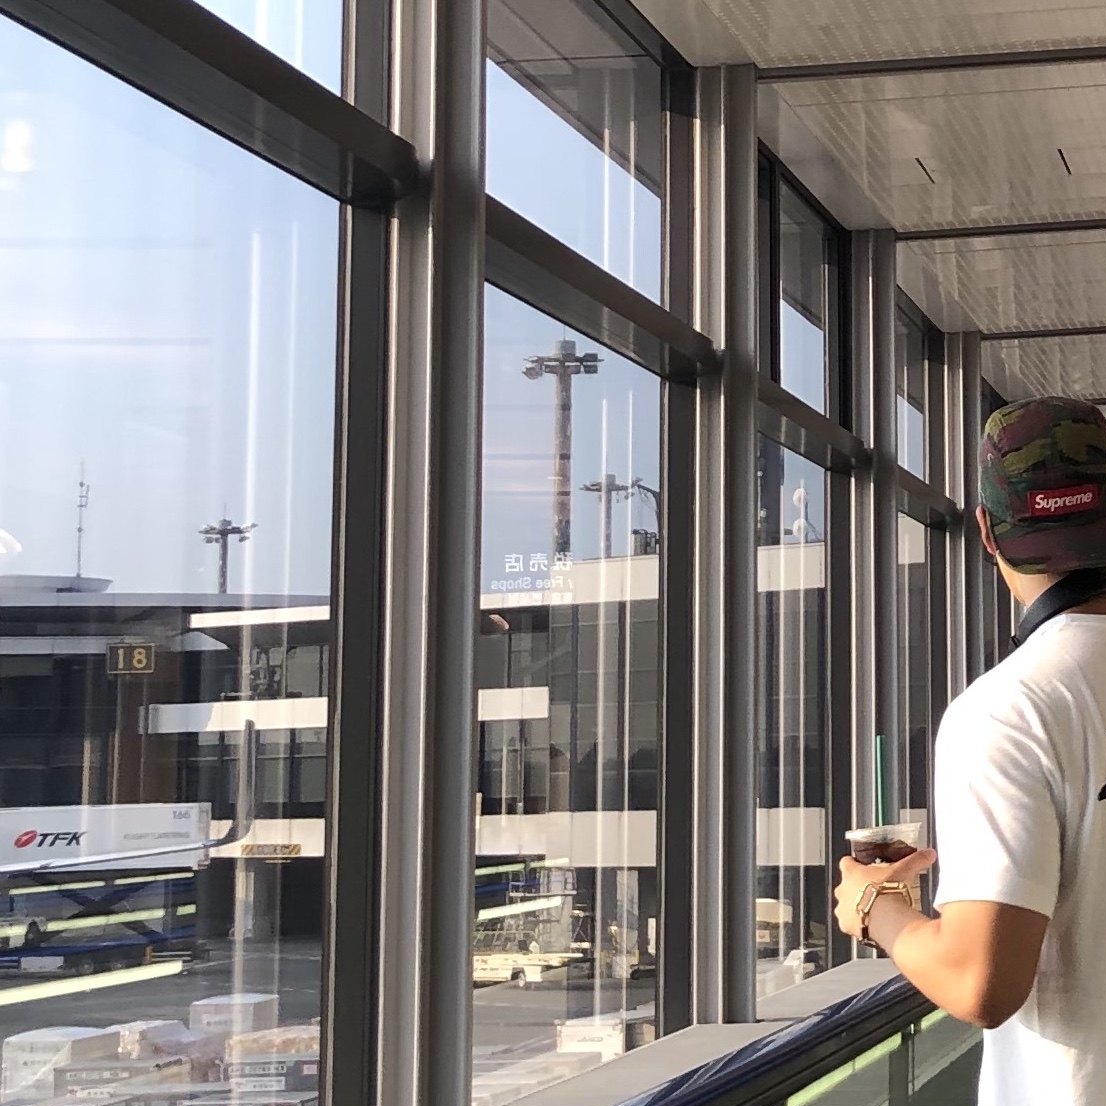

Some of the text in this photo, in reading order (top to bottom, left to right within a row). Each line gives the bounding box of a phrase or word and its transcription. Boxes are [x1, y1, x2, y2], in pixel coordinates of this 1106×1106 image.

[1035, 492, 1093, 512] Supreme
[118, 648, 147, 669] 18
[37, 831, 87, 847] TFK
